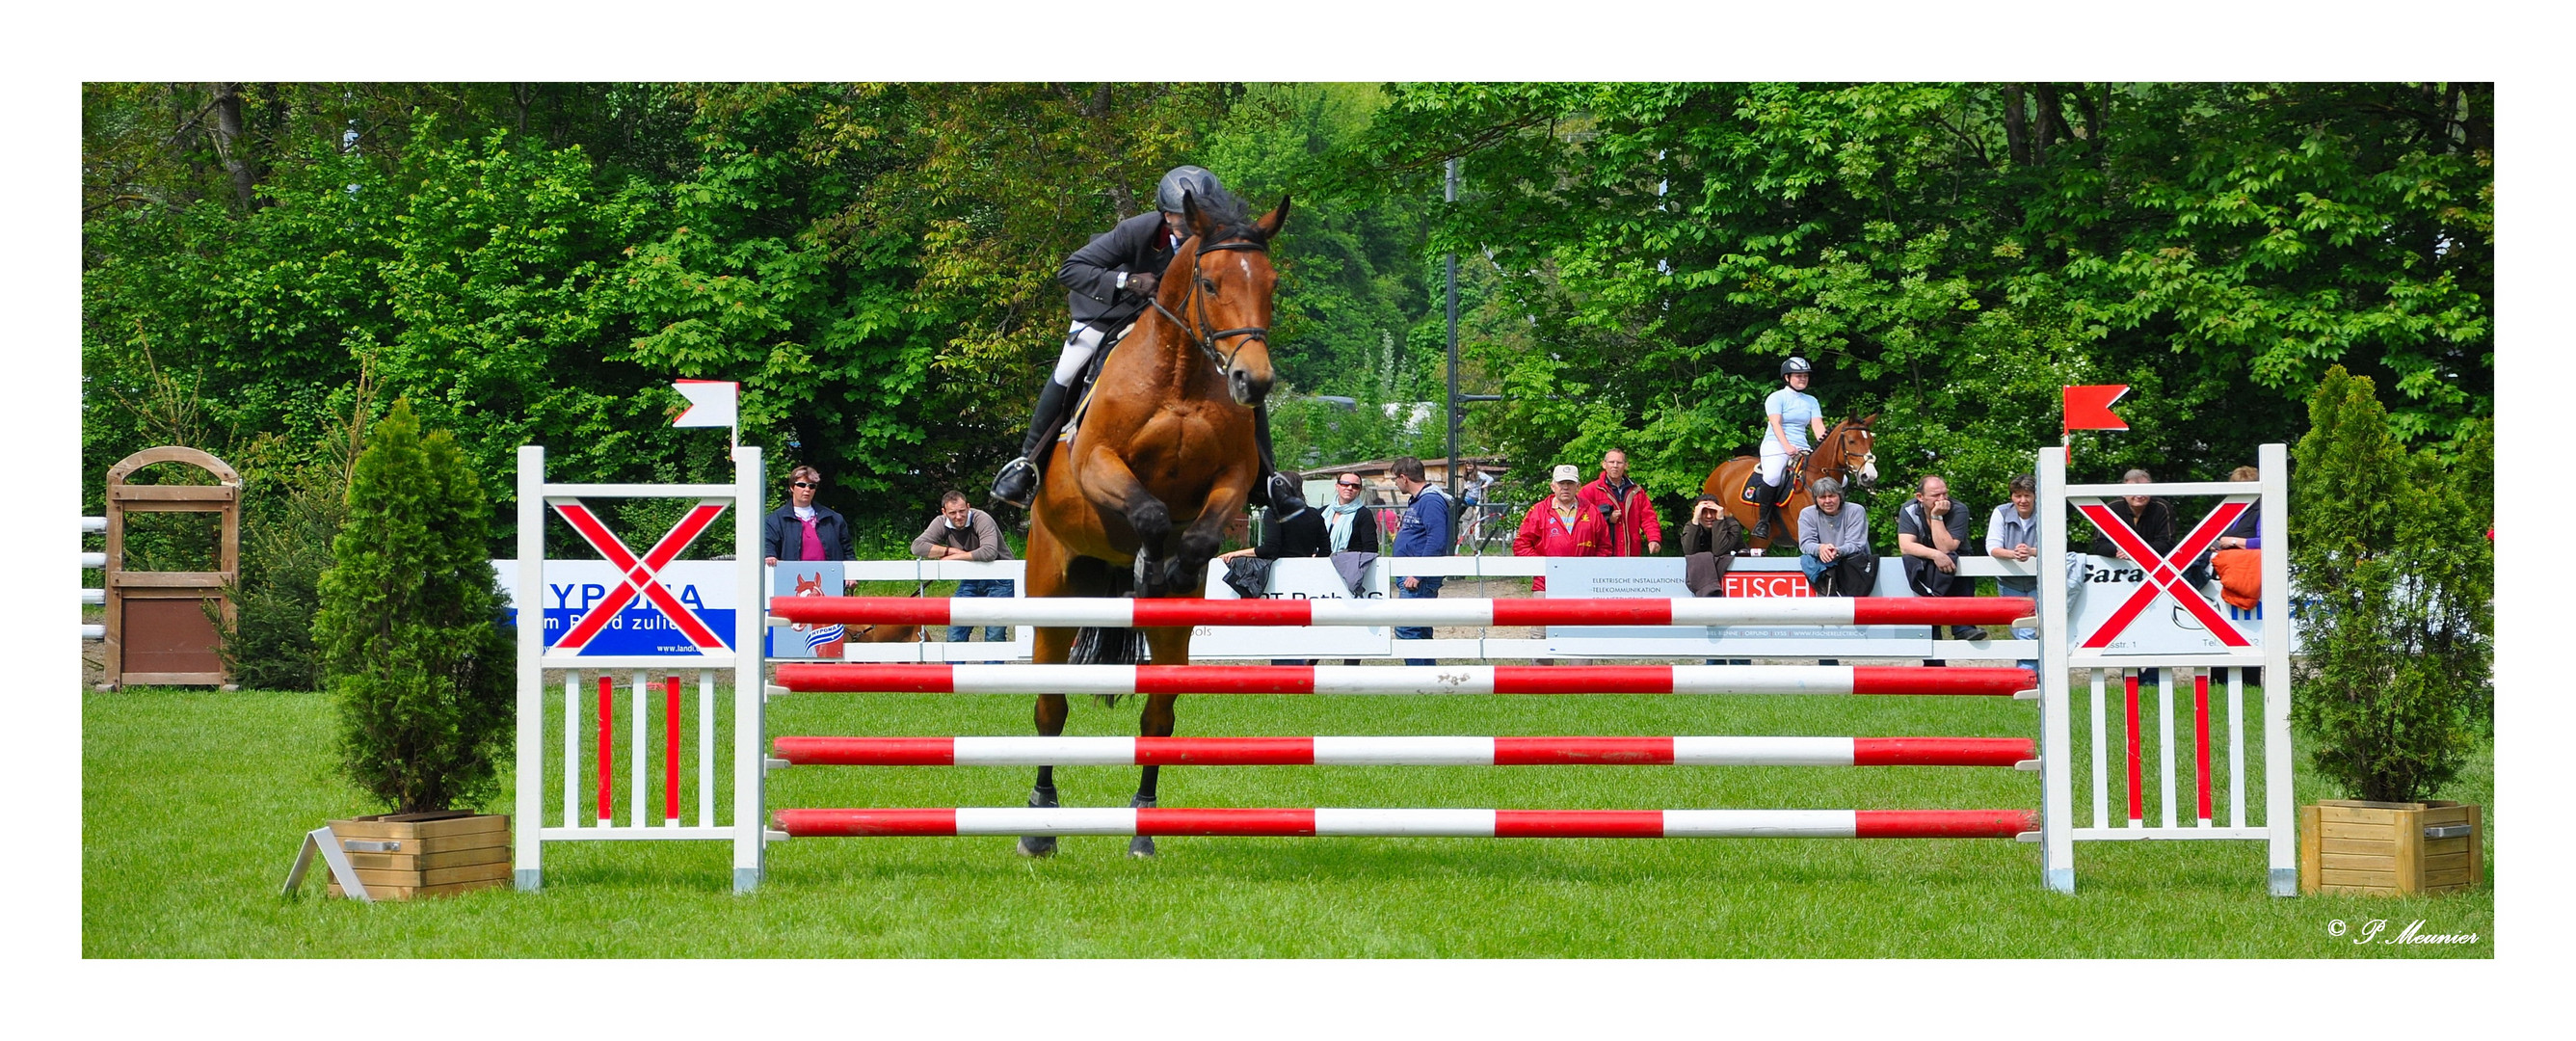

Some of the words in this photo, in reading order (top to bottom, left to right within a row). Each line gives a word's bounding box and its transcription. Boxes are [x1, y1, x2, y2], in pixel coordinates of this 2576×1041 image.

[549, 584, 704, 609] YPA
[1725, 577, 1810, 598] FISCH
[811, 626, 837, 636] HYPONA
